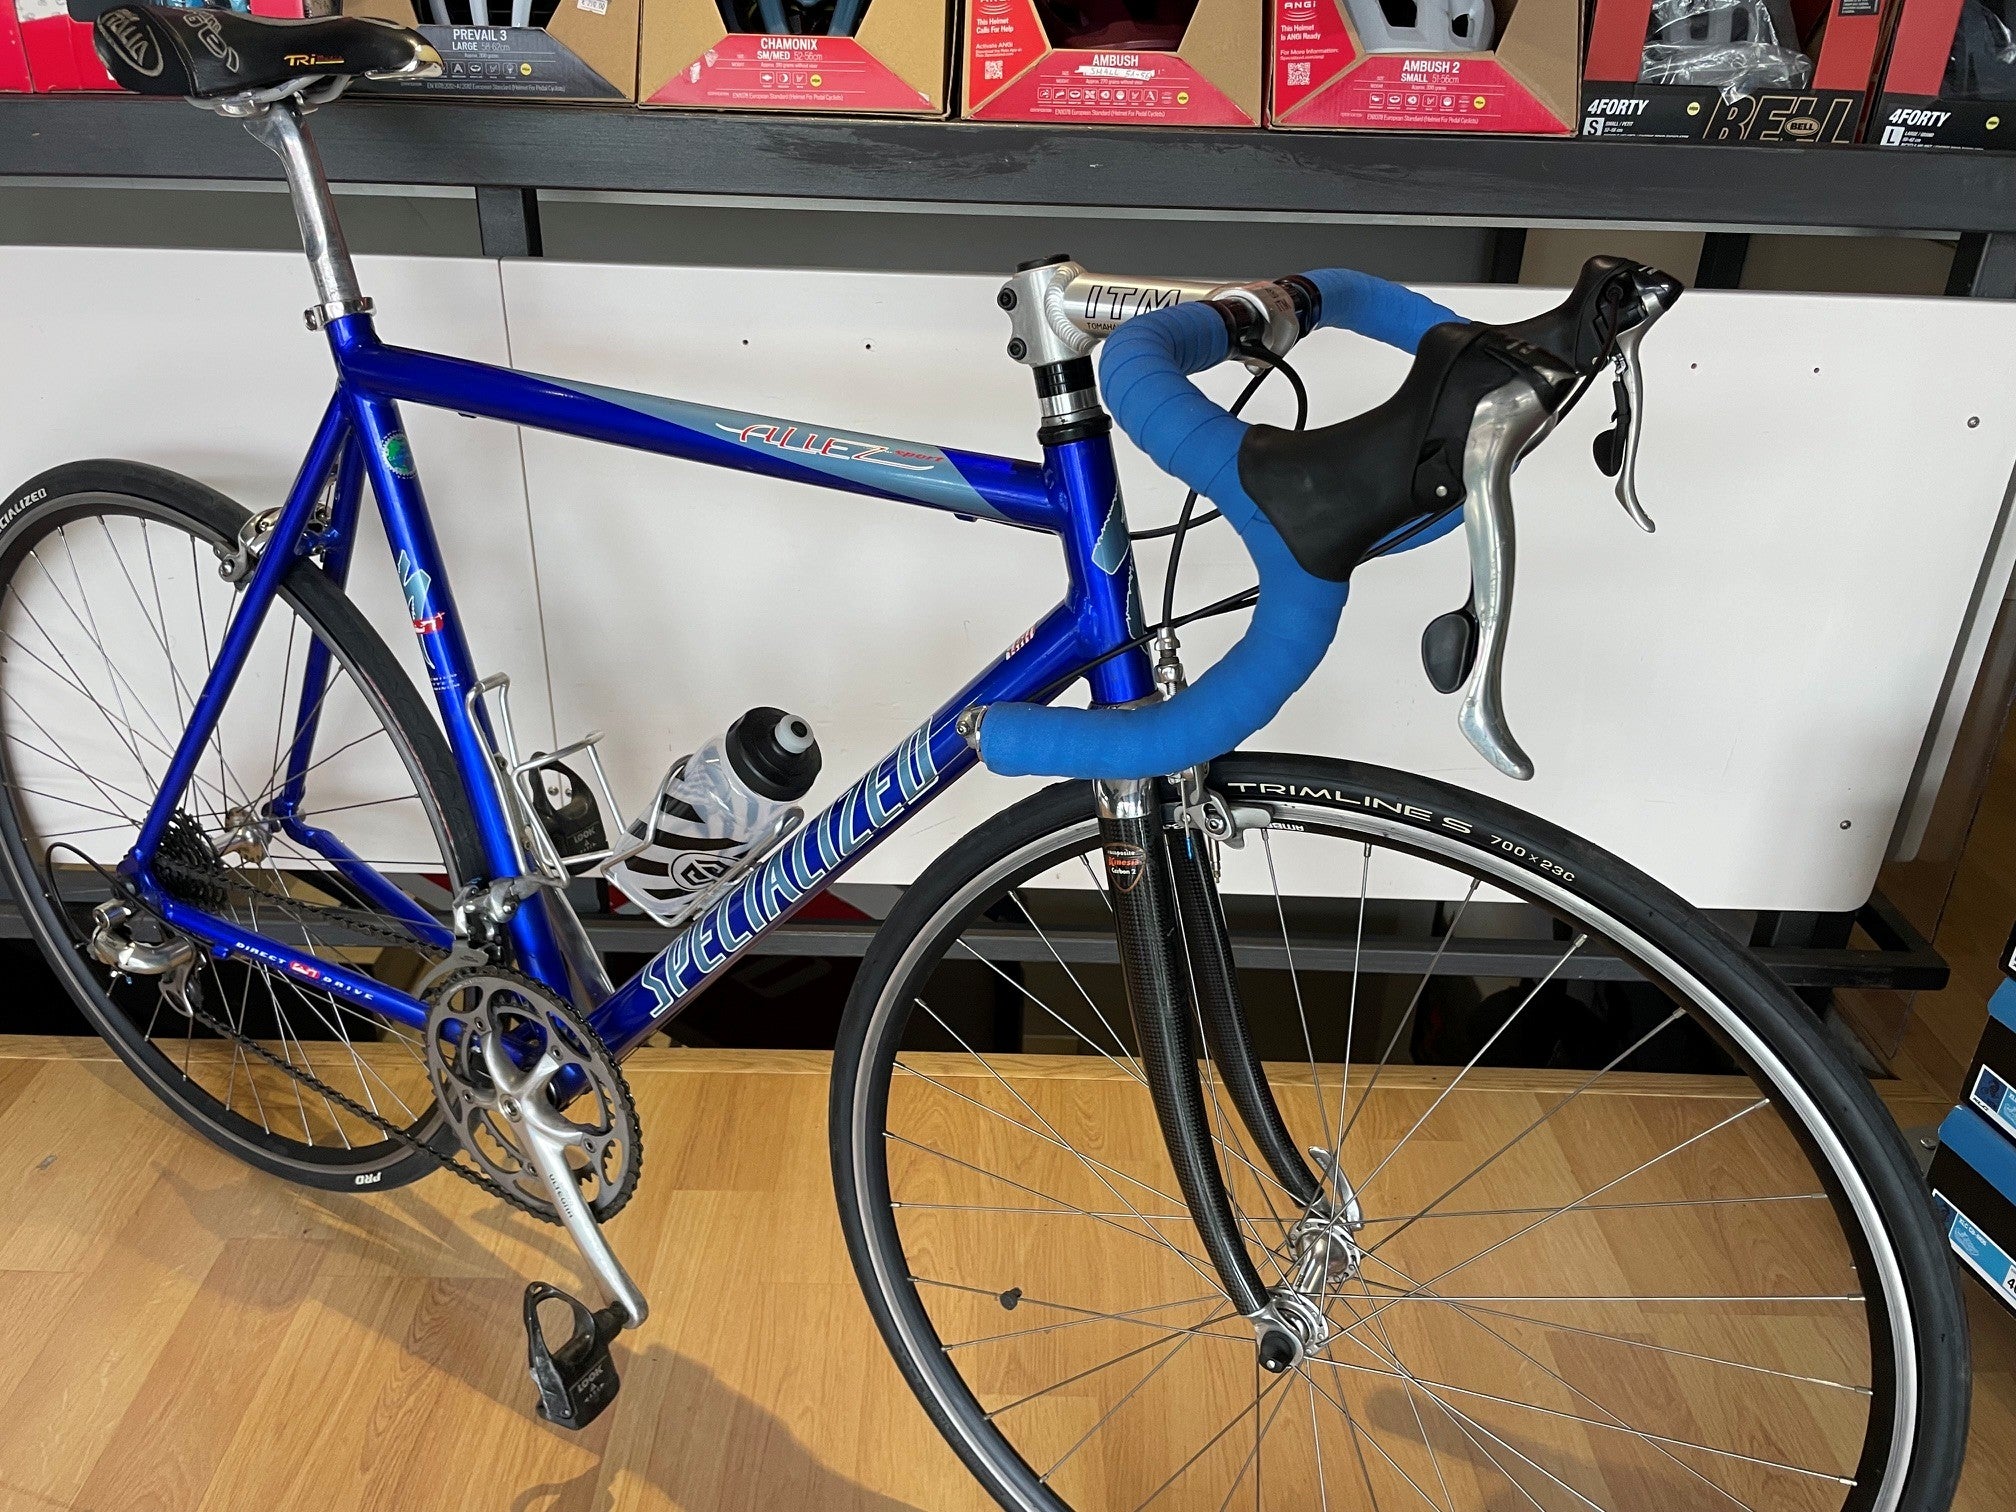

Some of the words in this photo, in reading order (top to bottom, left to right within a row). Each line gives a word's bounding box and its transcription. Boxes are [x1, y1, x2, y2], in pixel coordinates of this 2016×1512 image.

[453, 28, 496, 41] PREVAIL
[500, 30, 507, 41] 3
[452, 41, 478, 51] LARGE
[760, 37, 818, 50] CHAMONIX
[757, 50, 790, 61] SM/MED
[1092, 54, 1139, 67] AMBUSH
[1402, 60, 1450, 74] AMBUSH
[1452, 61, 1460, 74] 2
[1401, 73, 1428, 83] SMALL
[1587, 98, 1650, 116] 4FORTY
[1702, 95, 1854, 144] BELL
[1888, 103, 1952, 128] 4FORTY
[1587, 120, 1599, 136] S
[1789, 122, 1815, 132] BELL
[1885, 128, 1896, 144] L
[1083, 284, 1182, 321] ITM
[1086, 322, 1118, 331] TOMAHA
[722, 422, 926, 469] ALLEZ
[0, 487, 48, 534] CIALIZED
[1227, 781, 1434, 823] TRIMLINE
[1441, 816, 1474, 835] S
[641, 715, 940, 1019] SPECIALIZED
[235, 941, 287, 965] DIRECT
[322, 976, 375, 1001] DRIVE
[355, 1171, 382, 1186] PRO
